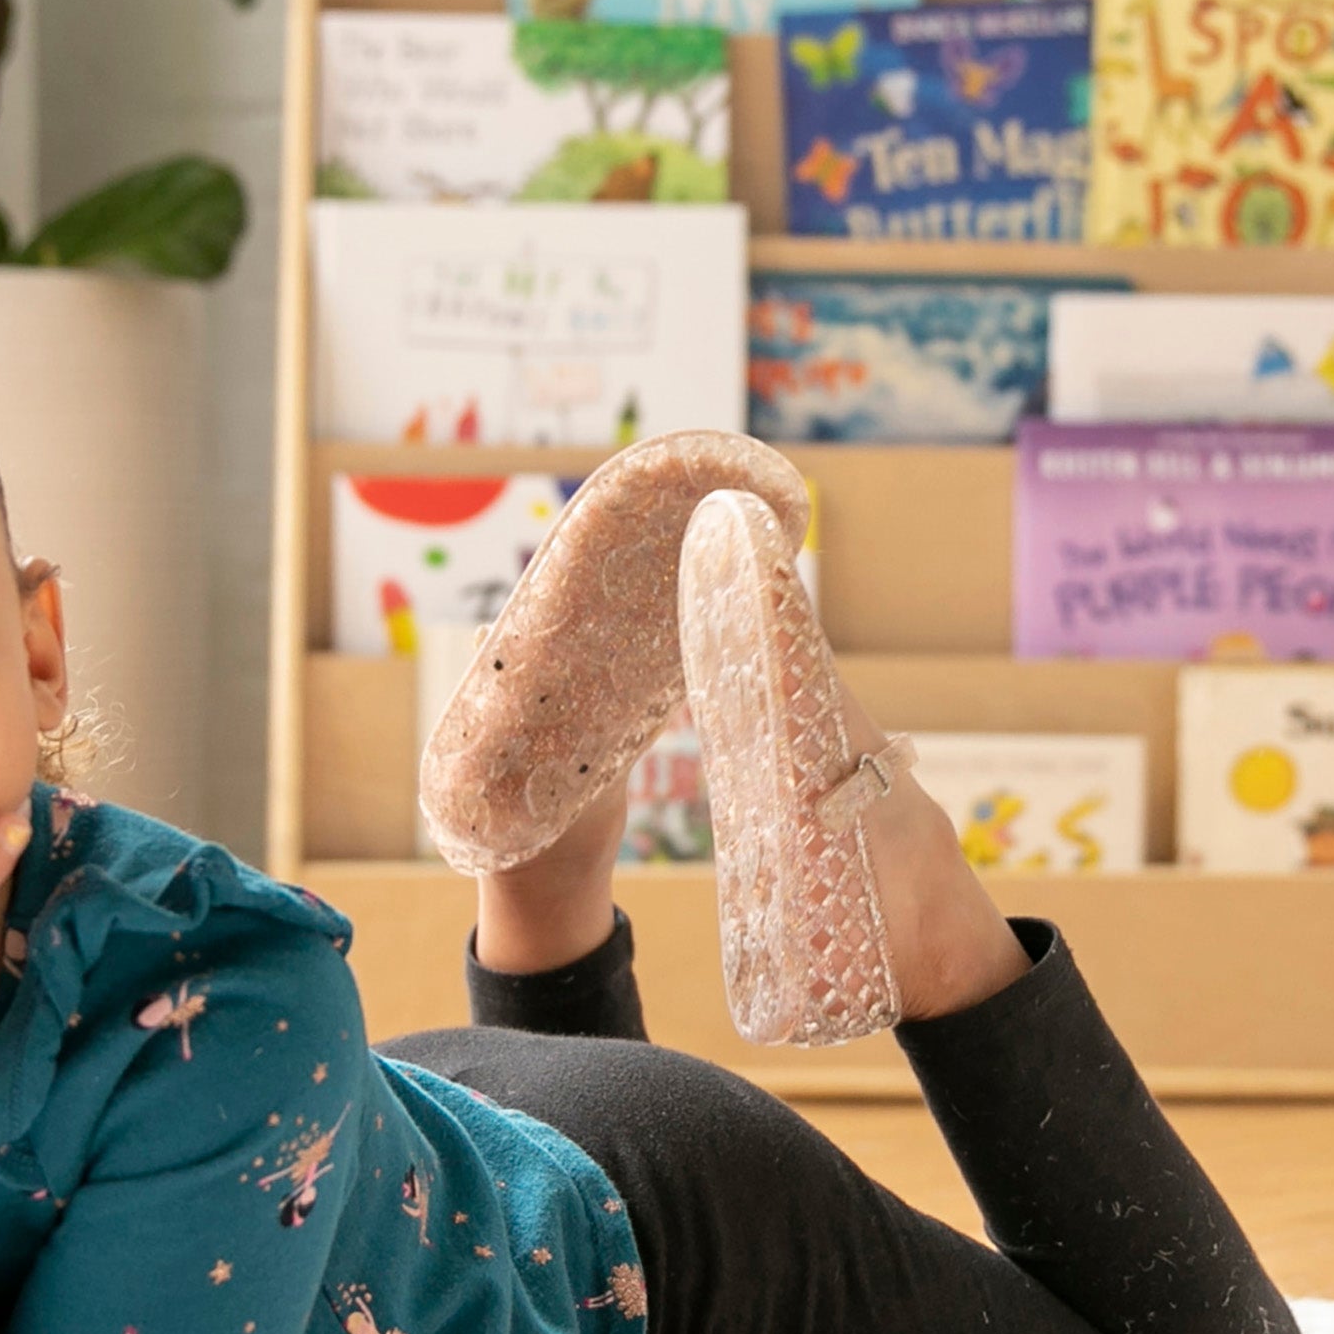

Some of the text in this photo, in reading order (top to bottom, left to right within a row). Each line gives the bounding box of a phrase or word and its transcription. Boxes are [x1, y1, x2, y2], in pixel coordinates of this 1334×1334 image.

[1214, 71, 1304, 162] A
[854, 127, 959, 192] Ten
[1054, 566, 1219, 629] PURPLE
